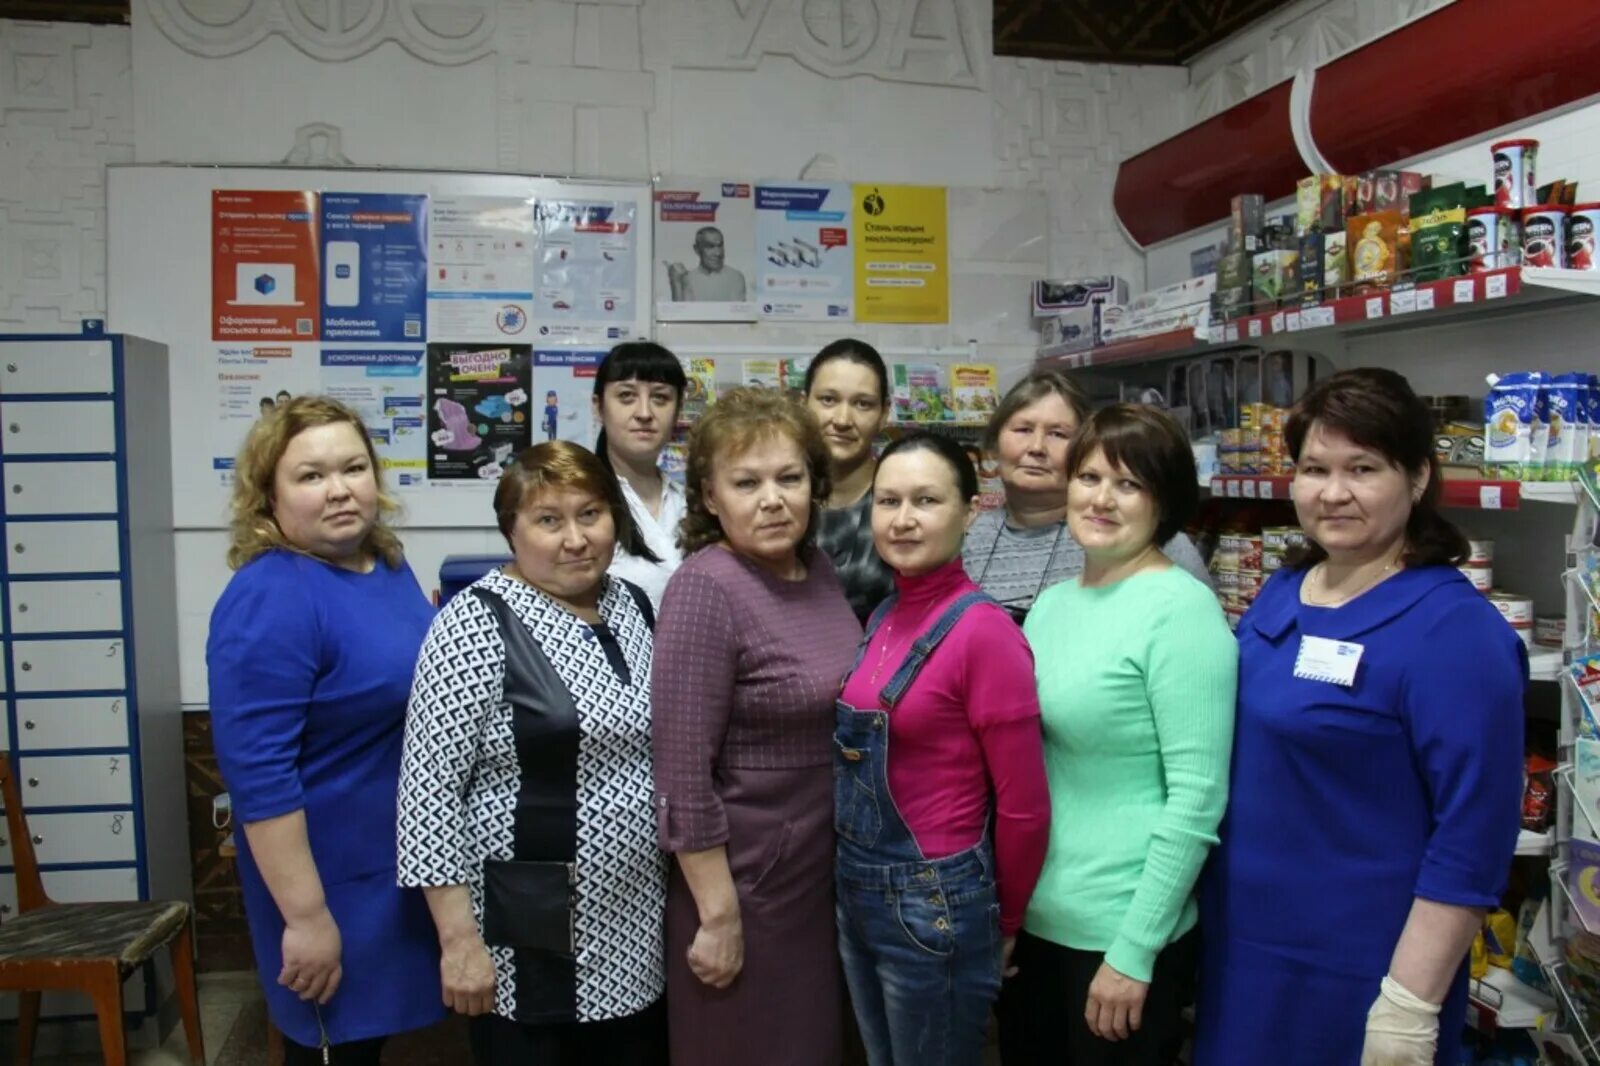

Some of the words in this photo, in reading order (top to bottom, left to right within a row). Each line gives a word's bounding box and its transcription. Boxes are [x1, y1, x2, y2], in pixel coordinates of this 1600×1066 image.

[864, 222, 892, 233] Стань
[893, 224, 925, 234] новым
[326, 318, 376, 328] Мобильное
[219, 326, 258, 335] посылок
[326, 328, 380, 338] приложение
[327, 354, 376, 363] УСКОРЕННАЯ
[377, 354, 417, 363] ДОСТАВКА
[453, 352, 507, 365] ВЫГОДНО
[539, 354, 563, 363] Ваша
[462, 363, 498, 374] ОЧЕНЬ
[106, 642, 121, 657] 5
[109, 757, 120, 775] 7
[109, 814, 124, 835] 8
